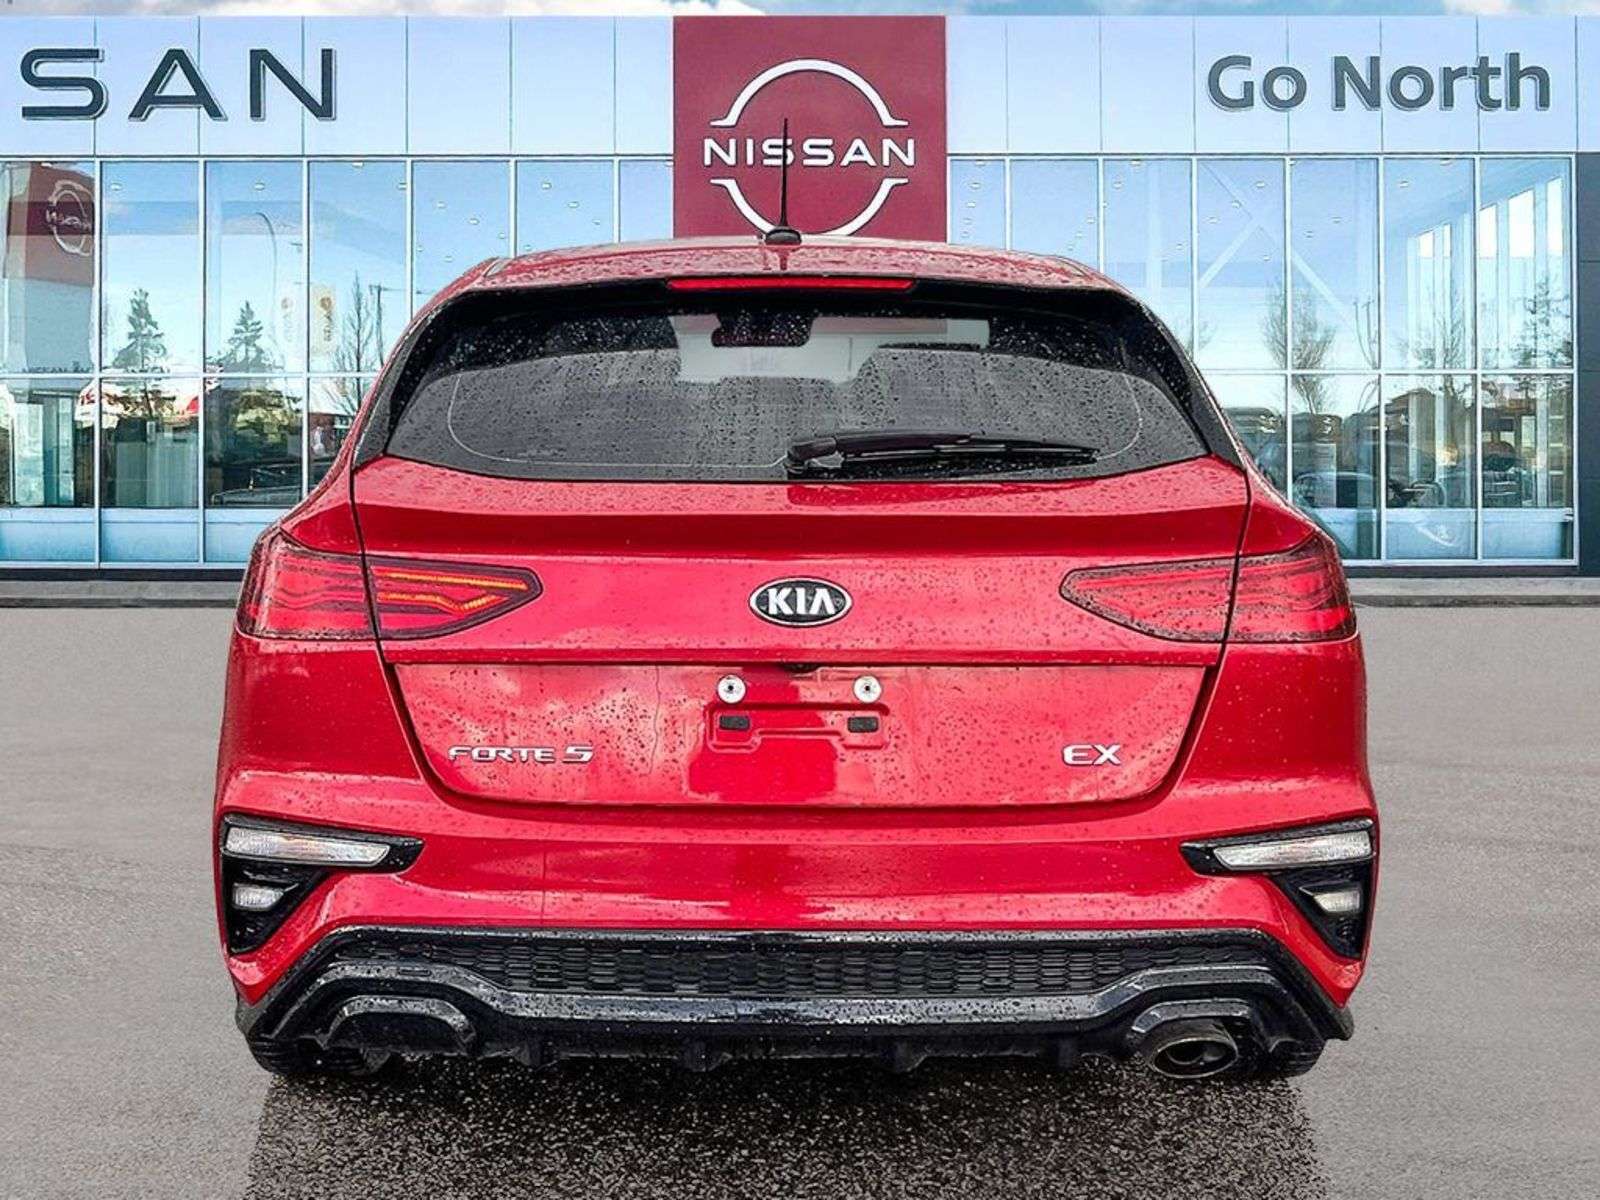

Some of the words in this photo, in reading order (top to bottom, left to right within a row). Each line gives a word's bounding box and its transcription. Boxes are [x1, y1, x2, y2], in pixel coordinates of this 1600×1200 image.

[20, 48, 337, 121] SAN
[1207, 54, 1308, 111] Go
[1330, 52, 1551, 112] North
[703, 138, 915, 167] NISSAN
[767, 586, 836, 615] KIA
[448, 745, 555, 763] FORTE
[562, 745, 594, 764] S
[1062, 743, 1121, 767] EX
